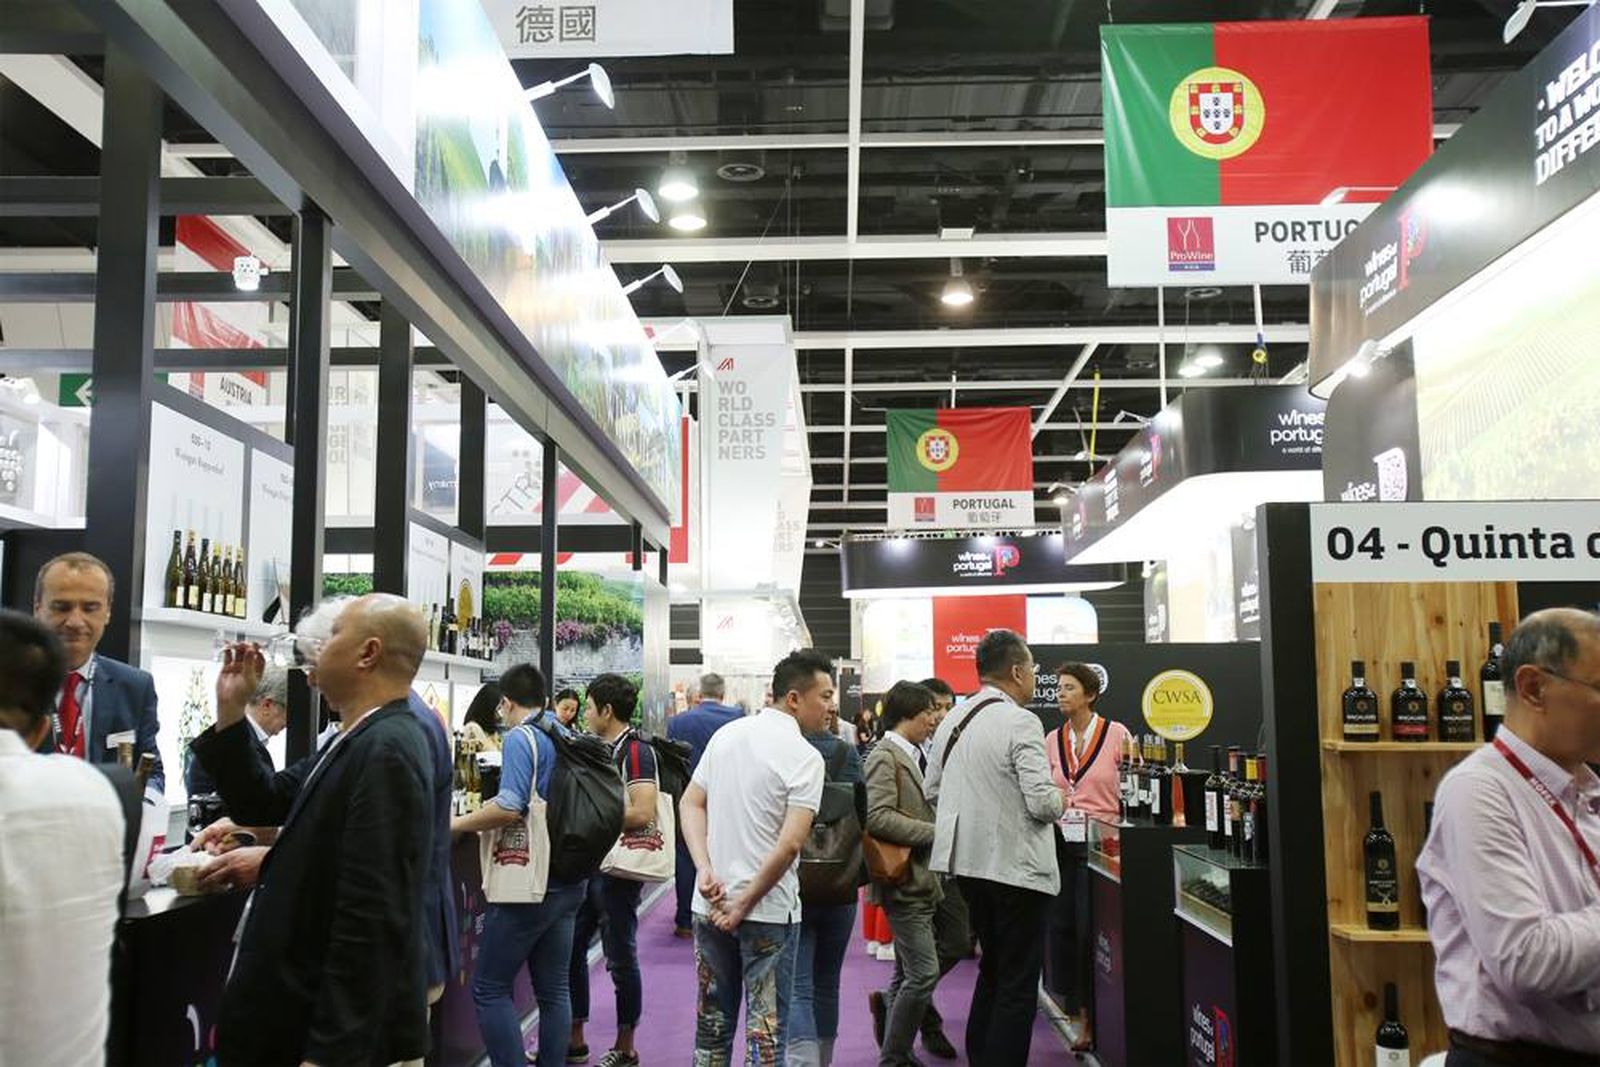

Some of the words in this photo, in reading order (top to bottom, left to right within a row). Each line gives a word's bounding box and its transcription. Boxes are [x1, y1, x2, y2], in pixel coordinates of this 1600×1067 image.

[515, 5, 597, 43] 德國
[219, 376, 252, 405] AUSTRIA
[718, 381, 747, 395] WO
[718, 397, 753, 411] RLD
[718, 413, 776, 427] CLASS
[718, 429, 765, 443] PART
[718, 445, 766, 459] NERS
[953, 499, 1016, 509] PORTUGAL
[1327, 526, 1385, 560] 04
[1421, 524, 1575, 567] Quinta
[953, 560, 993, 573] portugal
[1153, 690, 1203, 704] CWSA
